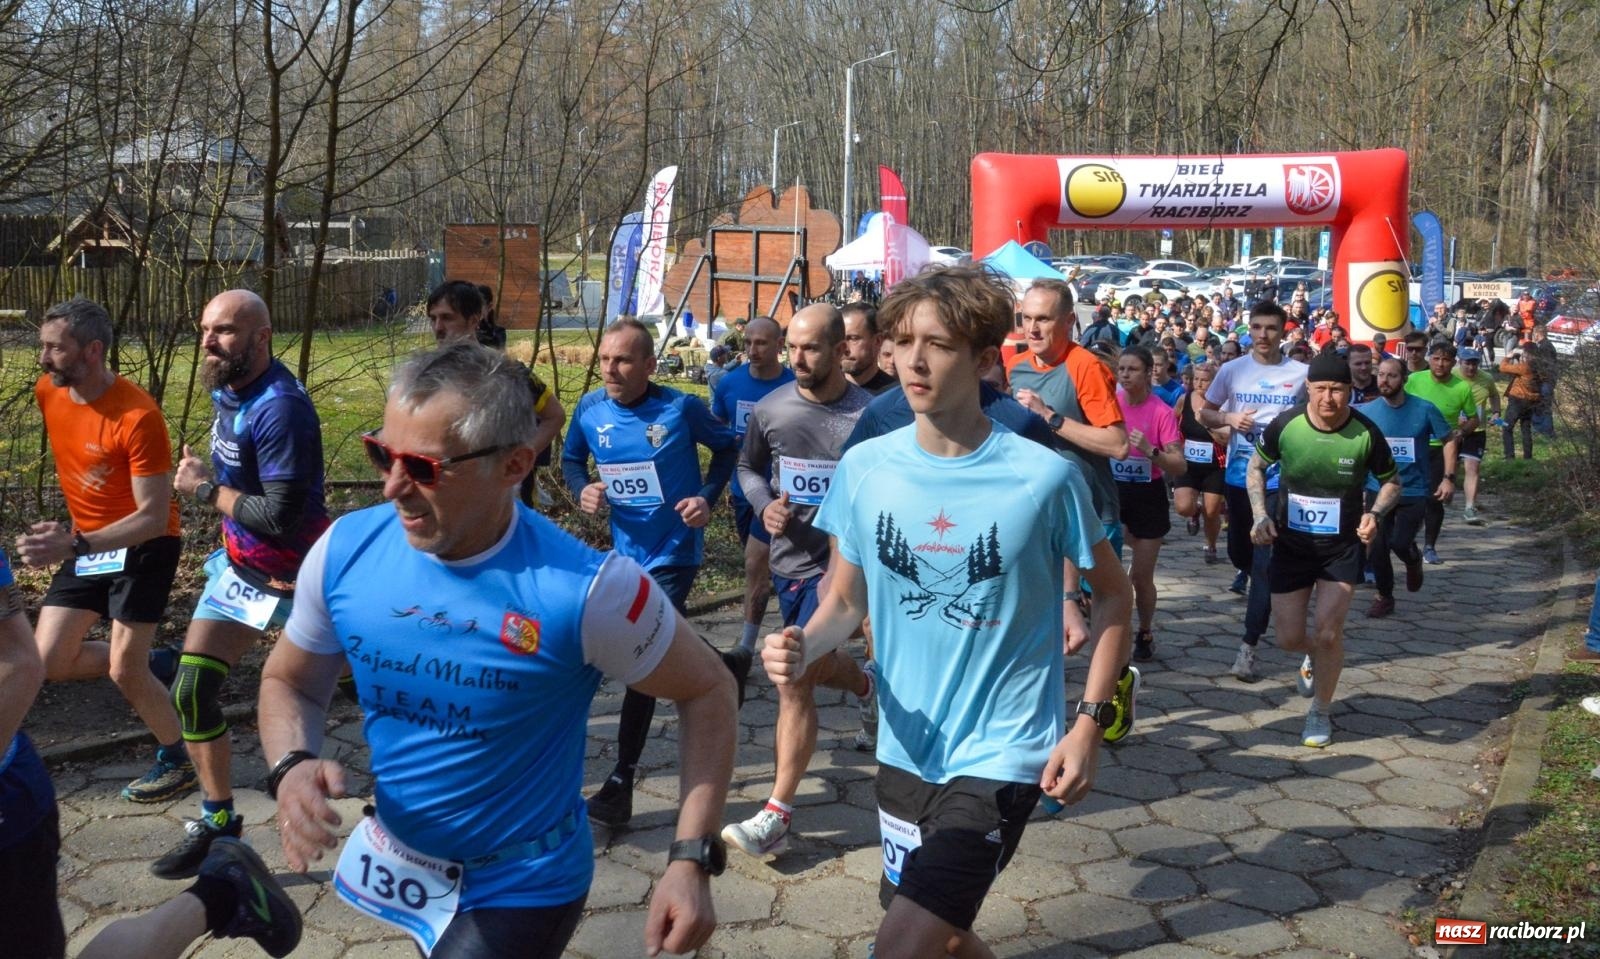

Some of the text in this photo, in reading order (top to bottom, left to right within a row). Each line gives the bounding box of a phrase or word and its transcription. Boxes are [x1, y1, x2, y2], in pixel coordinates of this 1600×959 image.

[1177, 164, 1224, 176] BIEG
[1139, 182, 1267, 198] TWARDZIELA
[1150, 201, 1252, 218] RACIBÓRZ
[1472, 283, 1500, 291] VAMOS
[1236, 392, 1297, 405] RUNNERS
[598, 434, 612, 449] PL
[1189, 447, 1206, 457] 012
[1115, 462, 1144, 475] 044
[612, 478, 649, 495] 059
[792, 474, 830, 493] 061
[1298, 509, 1328, 524] 107
[347, 635, 520, 691] Zajazd Malibu
[371, 684, 471, 721] TEAM
[360, 853, 428, 910] 130
